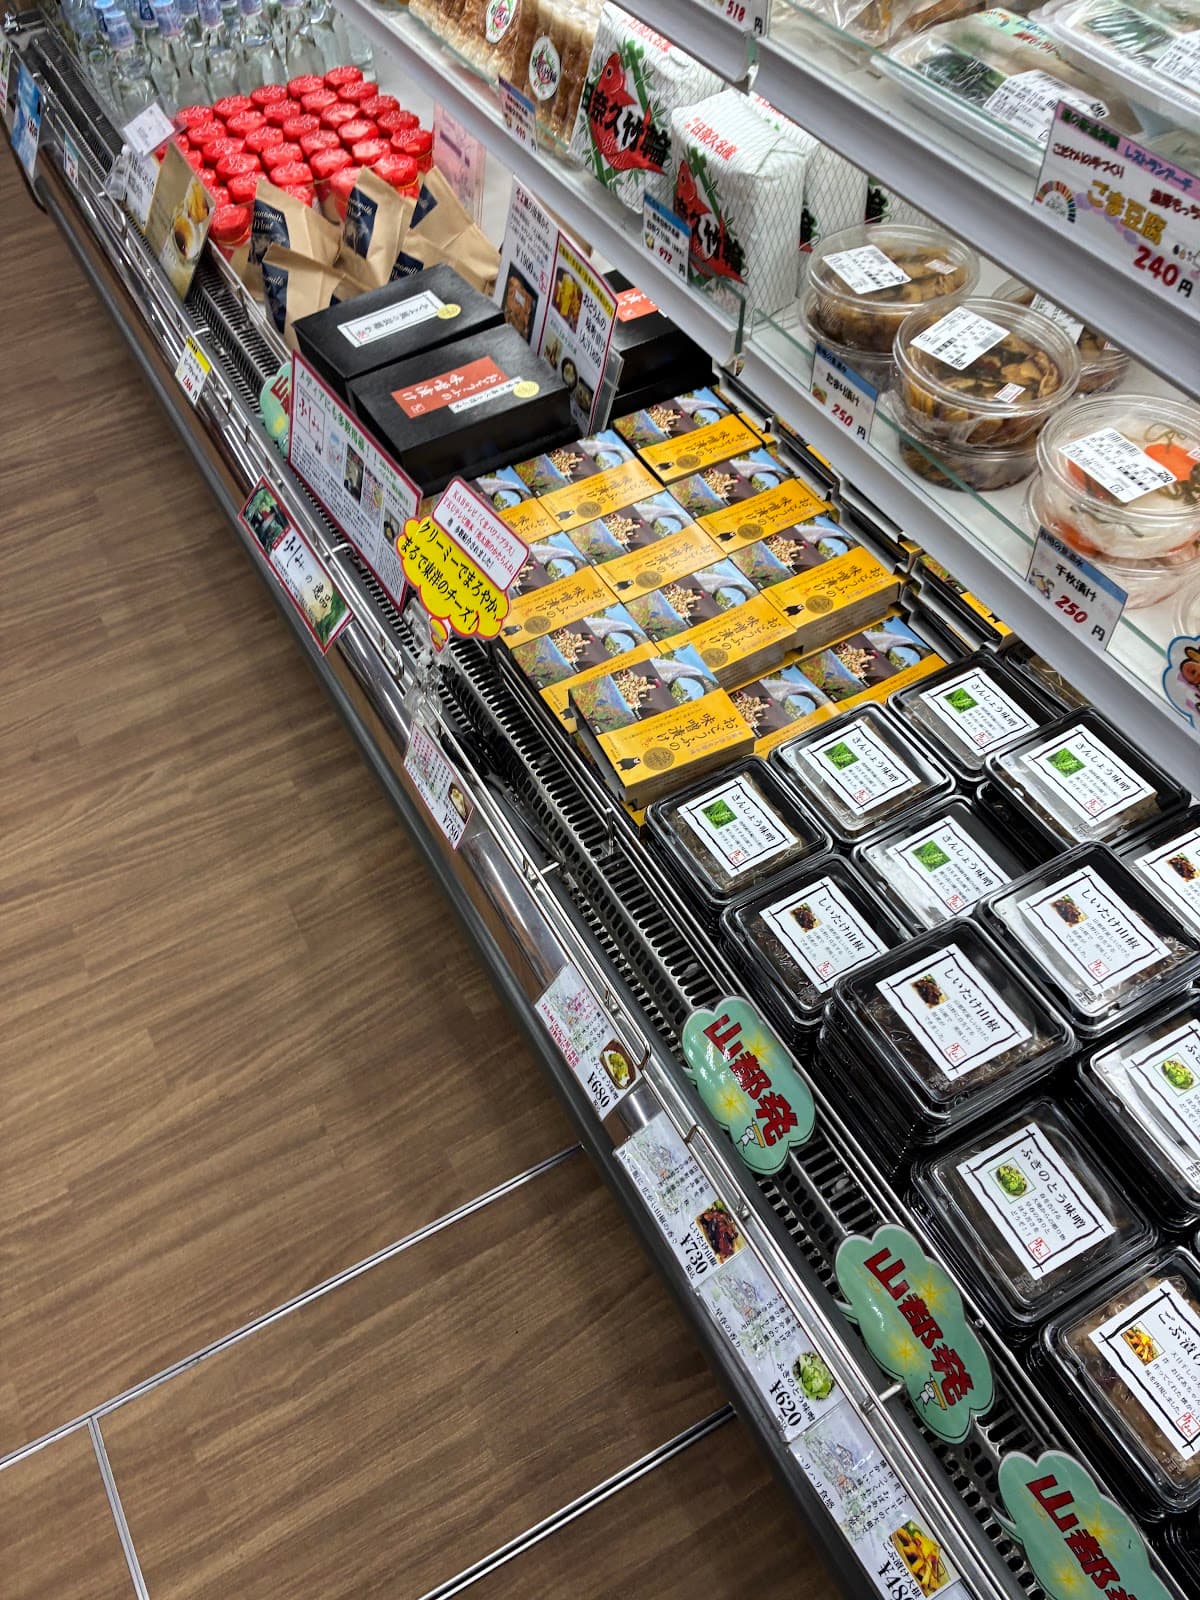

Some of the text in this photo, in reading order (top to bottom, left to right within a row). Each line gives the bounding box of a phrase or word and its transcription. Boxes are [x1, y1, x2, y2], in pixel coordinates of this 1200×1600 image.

[725, 0, 748, 22] 518
[1084, 177, 1169, 245] ごま豆腐
[1132, 245, 1194, 297] 240 円
[831, 403, 865, 439] 250 円
[398, 535, 478, 630] まるで東洋のチーズ!
[417, 518, 501, 619] クリーミーでまろやか、
[812, 562, 861, 593] 味噌漬け
[1054, 563, 1096, 602] 千枚漬け
[309, 581, 334, 610] 逸品
[1054, 593, 1107, 641] 250 円
[708, 613, 759, 646] 味噌漬け
[656, 709, 716, 745] 味噌漬け
[970, 681, 1016, 727] さんしょう味噌
[850, 734, 898, 783] さんしょう味噌
[1074, 740, 1131, 792] さんしょう味噌
[441, 813, 461, 841] ¥780
[729, 792, 775, 843] さんしょう味噌
[941, 832, 992, 888] さんしょう味噌
[817, 896, 864, 951] しいたけ山椒
[1080, 887, 1141, 950] しいたけ山椒
[942, 966, 1000, 1032] しいたけ山椒
[585, 1072, 612, 1108] ¥680
[589, 1056, 619, 1100] さんしょう味噌
[701, 1010, 804, 1148] 山都発
[1018, 1145, 1087, 1229] ふきのとう味噌
[679, 1233, 709, 1276] ¥730
[686, 1221, 718, 1267] しいたけ山椒
[684, 1263, 696, 1278] 税込
[862, 1243, 981, 1408] 山都発
[767, 1379, 804, 1428] ¥620
[775, 1360, 816, 1422] ふきのとう味噌
[1143, 1369, 1182, 1415] 味を再現しました。
